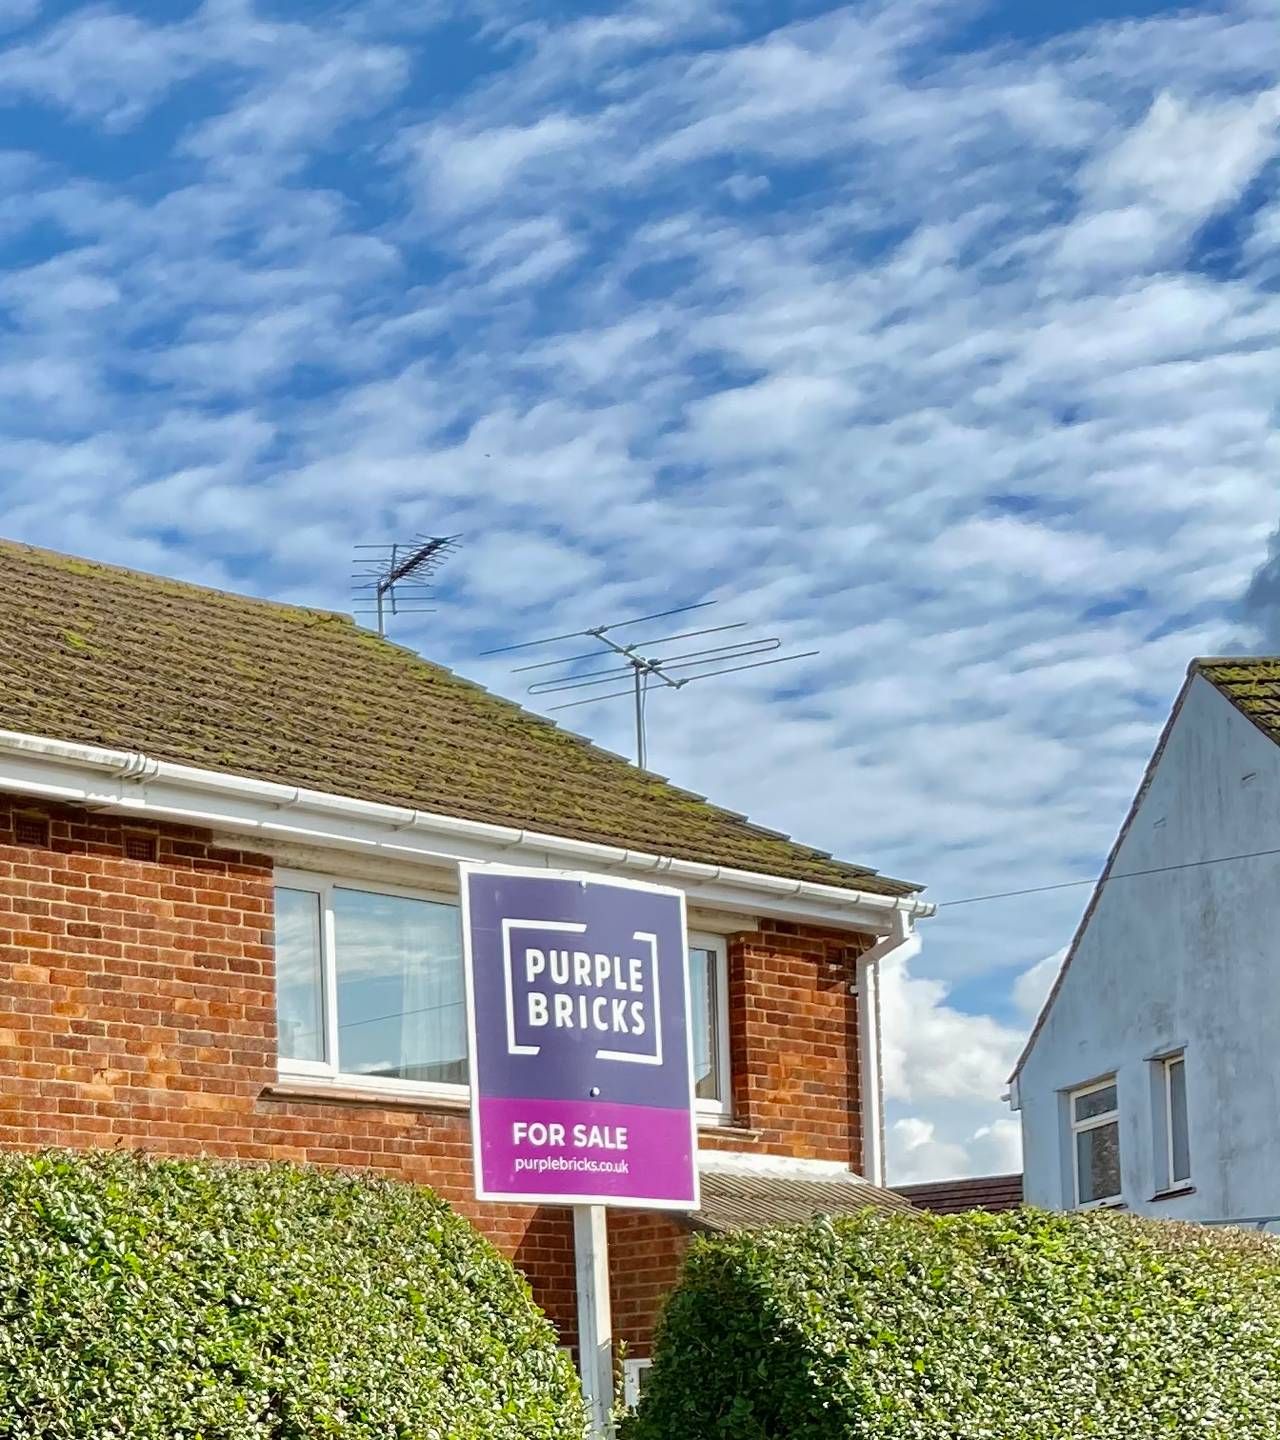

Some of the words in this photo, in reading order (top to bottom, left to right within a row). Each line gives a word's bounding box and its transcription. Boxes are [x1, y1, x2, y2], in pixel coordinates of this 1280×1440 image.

[525, 948, 645, 993] PURPLE
[527, 991, 646, 1036] BRICKS
[512, 1122, 566, 1147] FOR
[573, 1124, 629, 1150] SALE
[515, 1156, 629, 1174] purplebricks.co.uk
